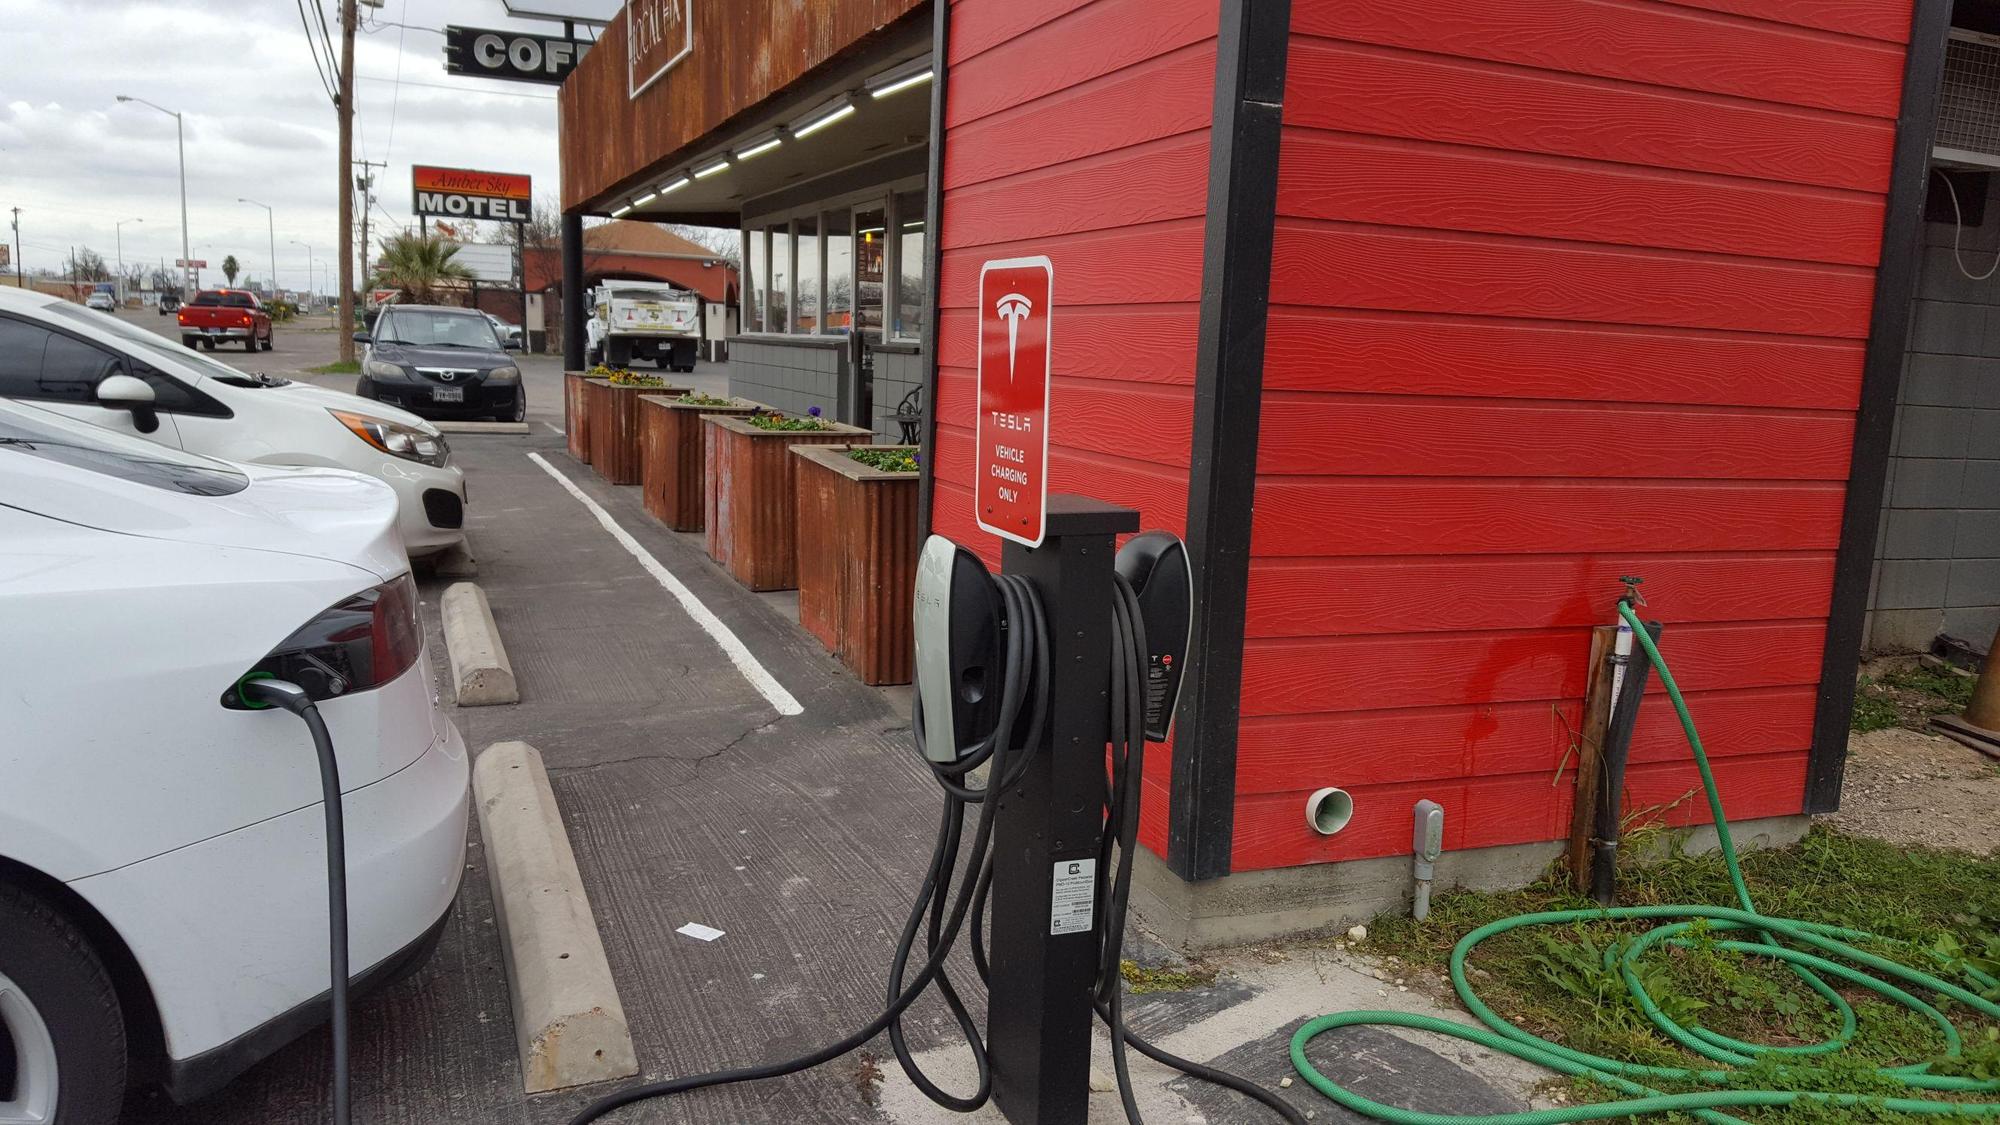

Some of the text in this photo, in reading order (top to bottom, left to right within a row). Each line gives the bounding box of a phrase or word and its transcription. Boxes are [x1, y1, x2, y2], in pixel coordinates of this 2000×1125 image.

[432, 172, 511, 196] Amber Sky
[418, 192, 526, 219] MOTEL
[991, 411, 1031, 433] TESLA
[995, 444, 1025, 463] VEHICLE
[991, 464, 1028, 485] CHARGING
[998, 486, 1018, 503] ONLY
